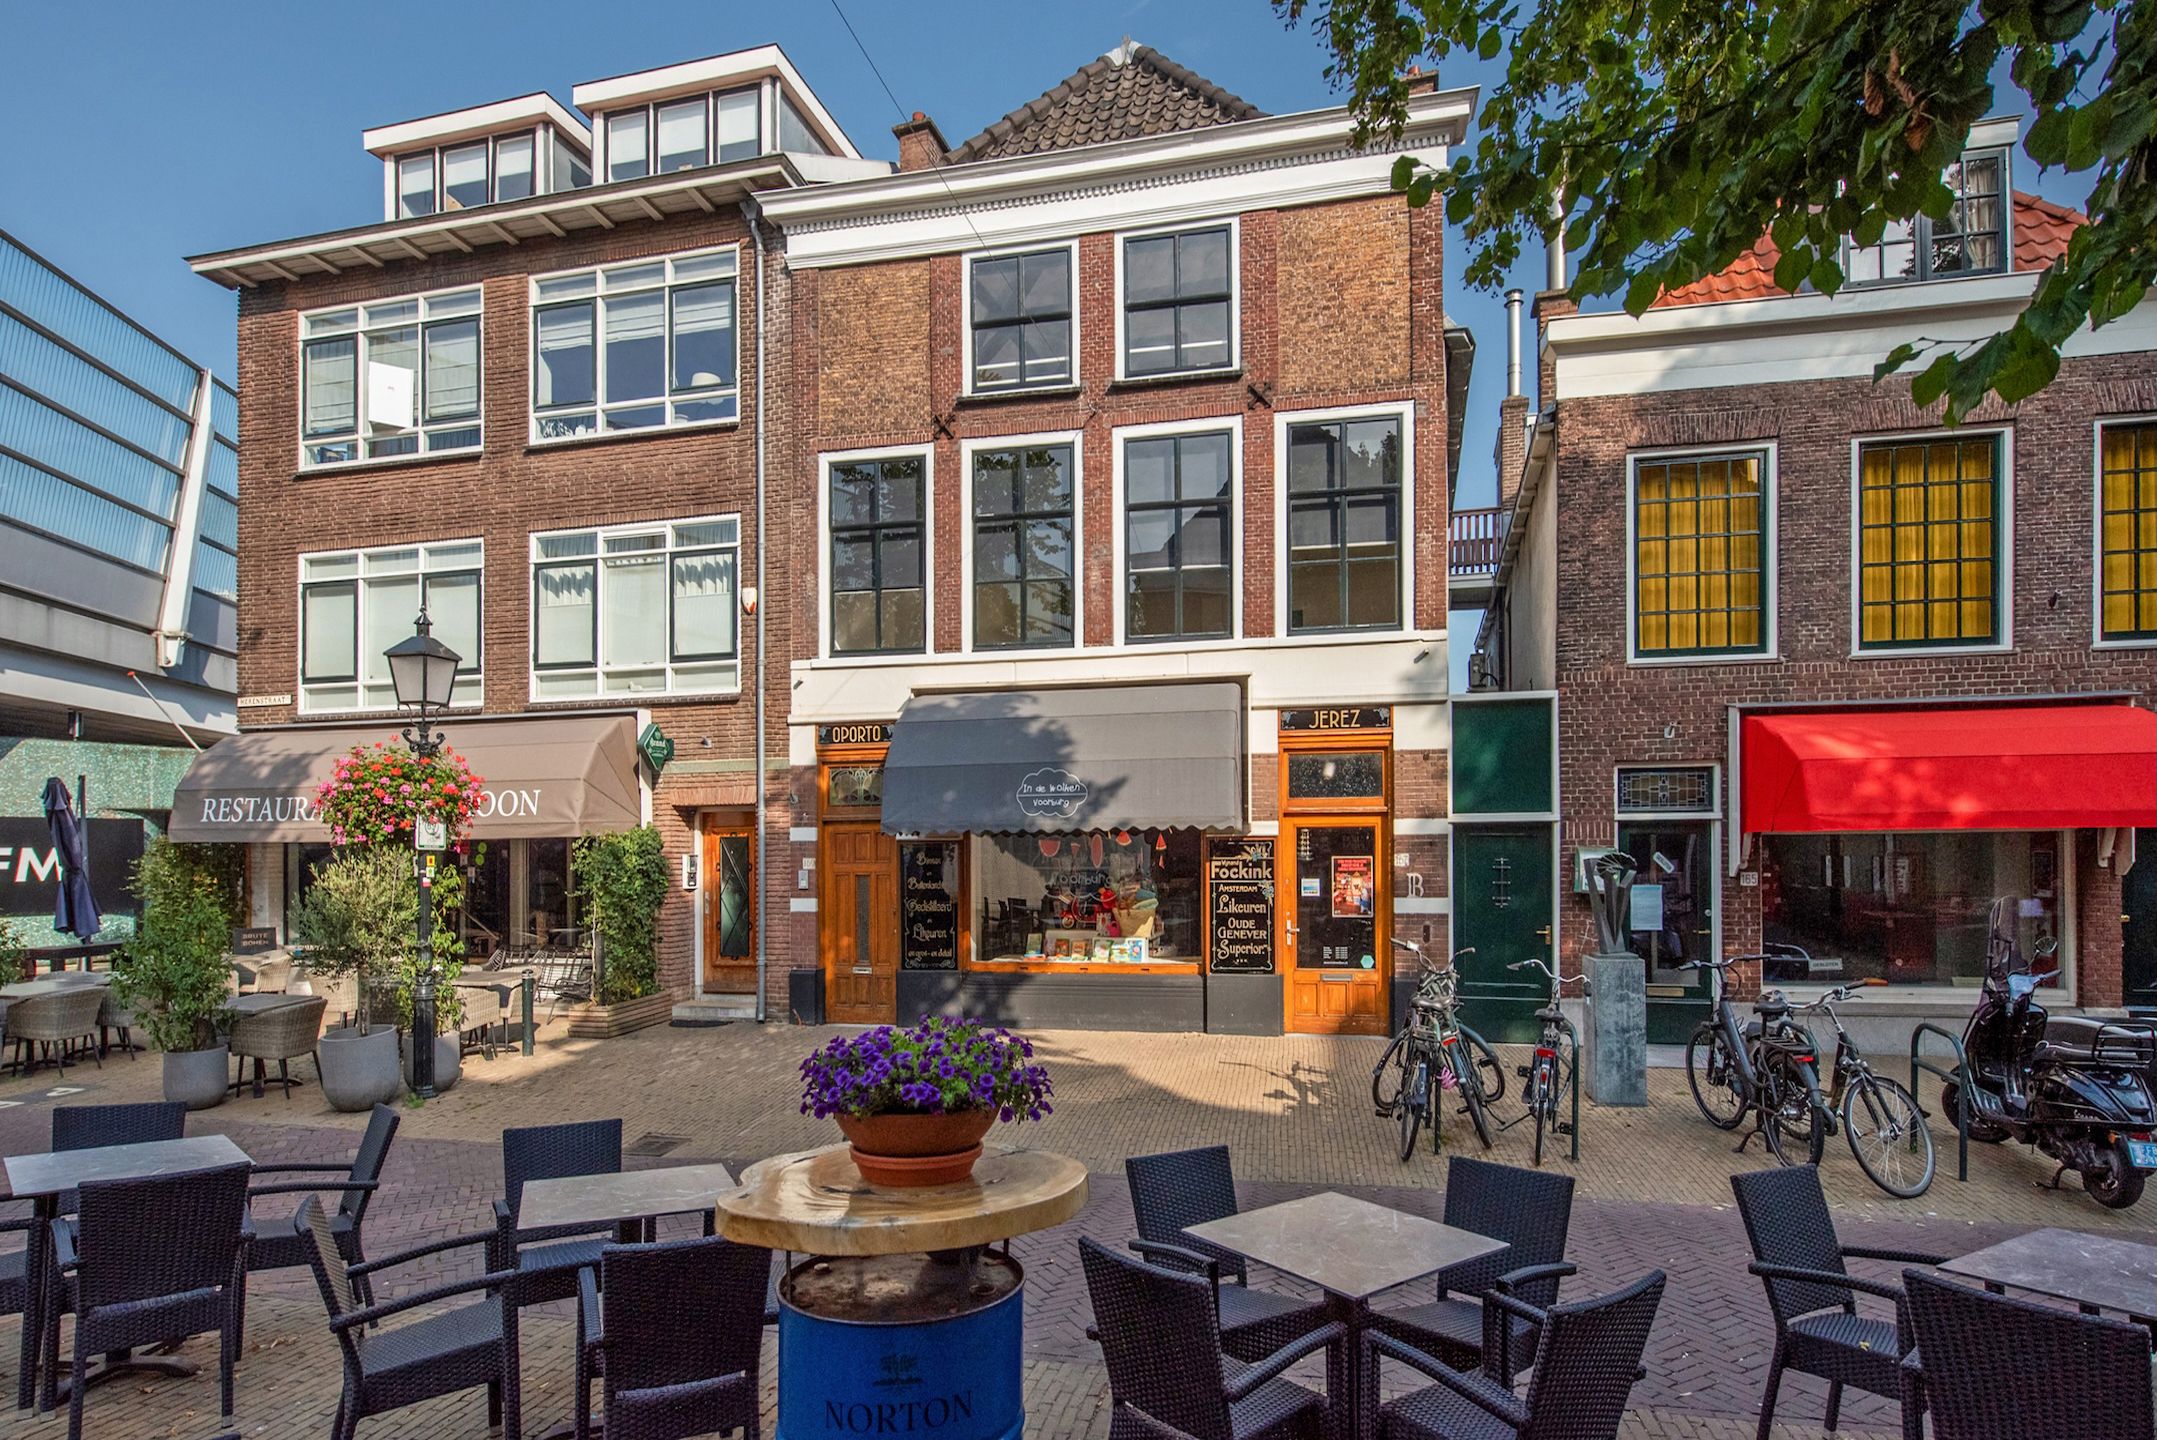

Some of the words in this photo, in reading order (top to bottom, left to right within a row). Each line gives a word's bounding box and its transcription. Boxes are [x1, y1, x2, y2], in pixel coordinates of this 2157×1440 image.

[1308, 709, 1361, 729] JEREZ
[832, 725, 881, 743] OPORTO
[1023, 784, 1033, 793] In
[1035, 784, 1047, 793] de
[201, 797, 325, 822] RESTAURA
[466, 789, 542, 817] OON
[1211, 860, 1273, 879] Fockink
[1741, 873, 1757, 885] 165
[1218, 884, 1258, 893] AMSTERDAM
[1216, 894, 1267, 914] Likeuren
[1227, 917, 1256, 929] OUDE
[1217, 927, 1267, 940] GENEVER
[824, 1390, 974, 1434] NORTON
